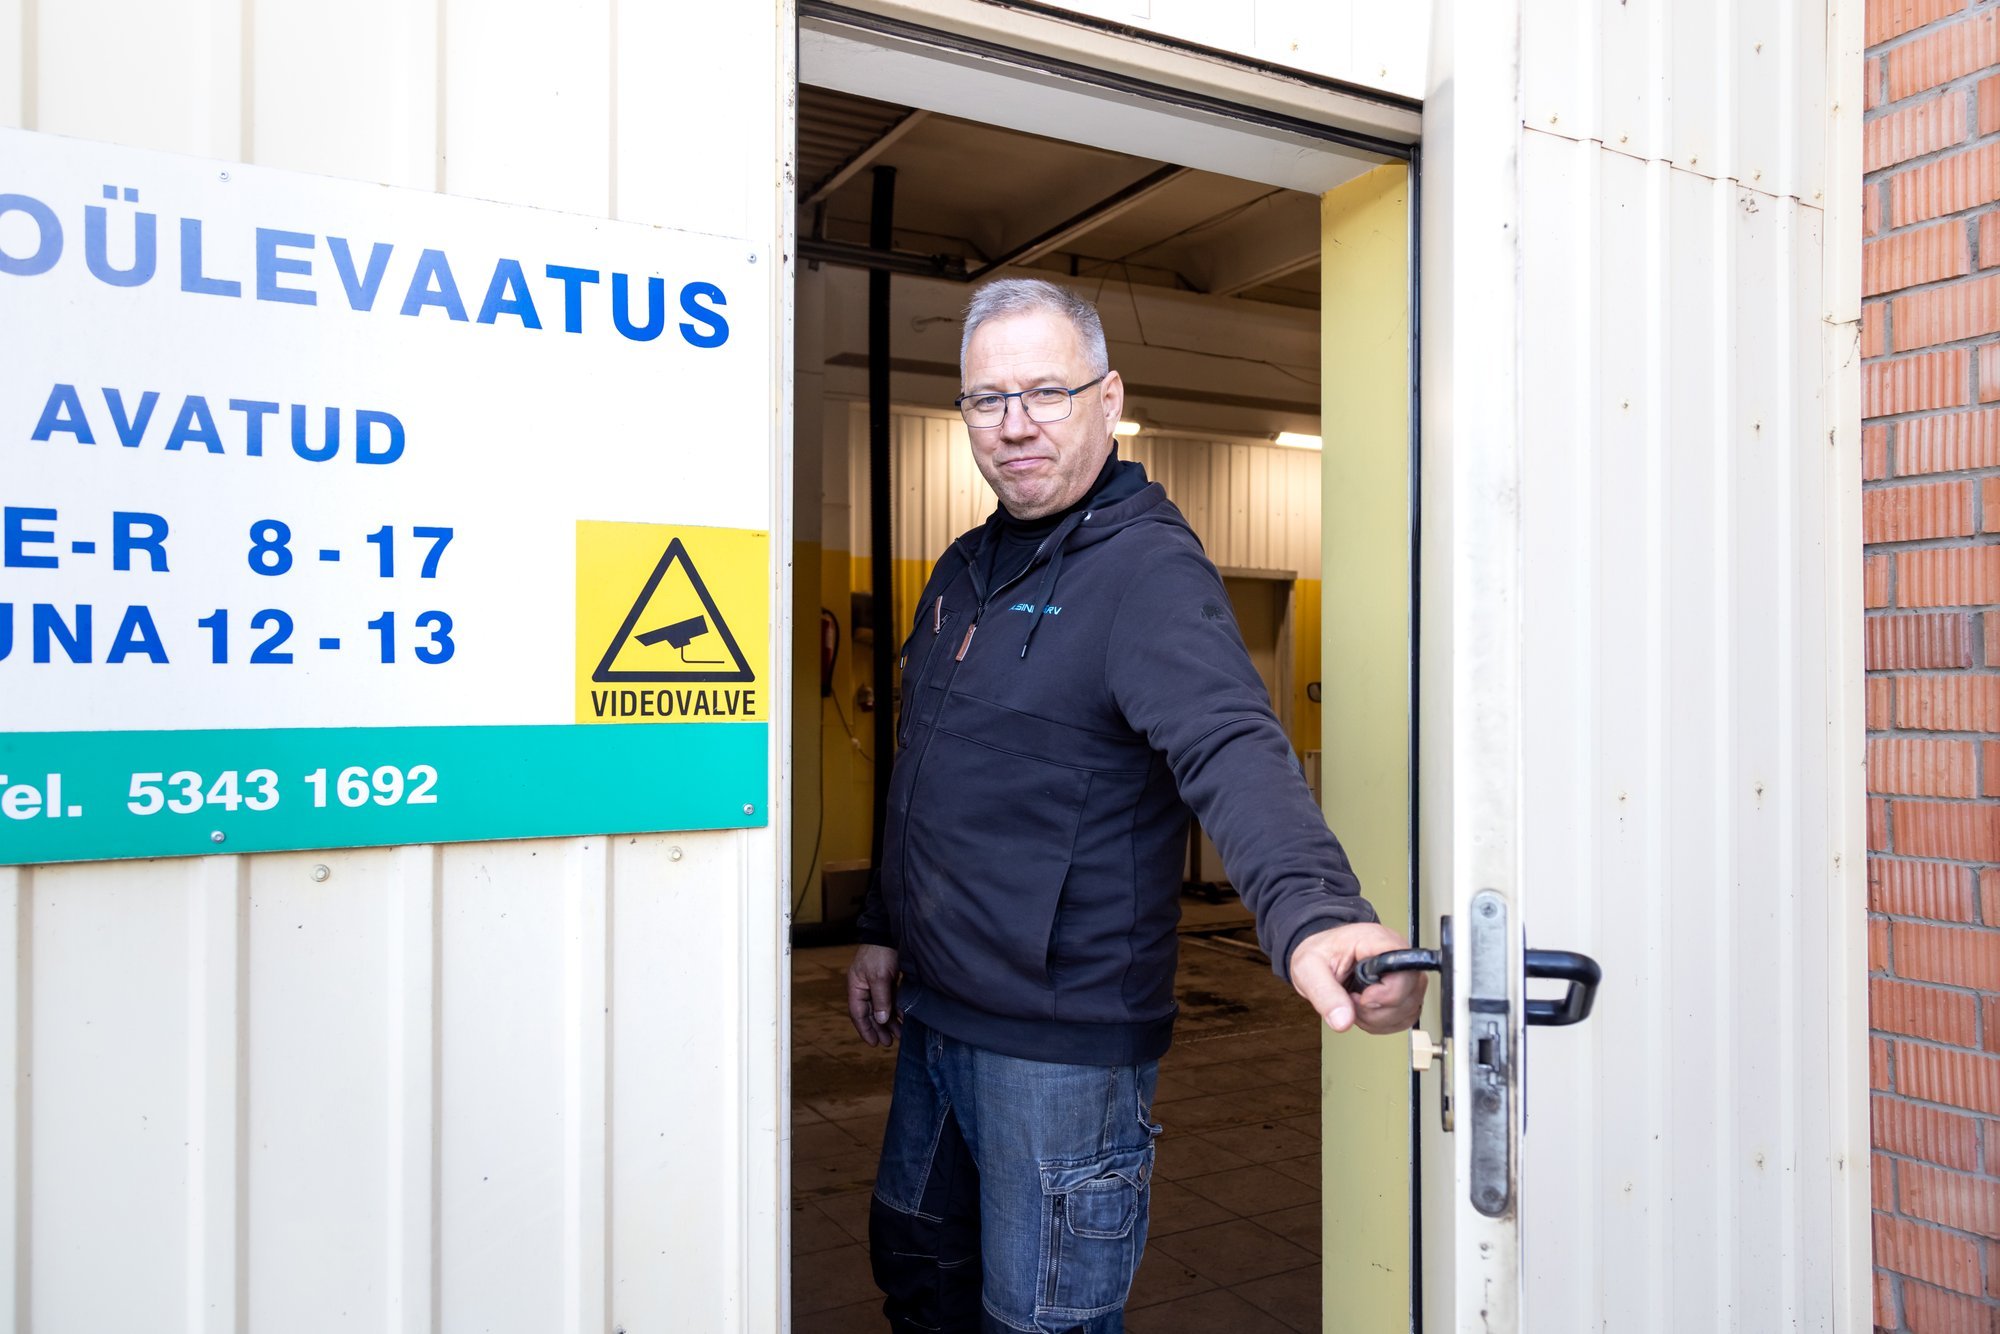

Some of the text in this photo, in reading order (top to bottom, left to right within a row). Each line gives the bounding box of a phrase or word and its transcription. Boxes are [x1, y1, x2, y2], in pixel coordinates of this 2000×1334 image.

[0, 184, 730, 349] OÜLEVAATUS
[31, 383, 406, 466] AVATUD
[3, 505, 455, 580] E-R 8 - 17
[198, 607, 295, 665] 12
[318, 637, 341, 651] -
[367, 609, 456, 666] 13
[591, 689, 756, 717] VIDEOVALVE
[0, 764, 439, 820] el. 5343 1692
